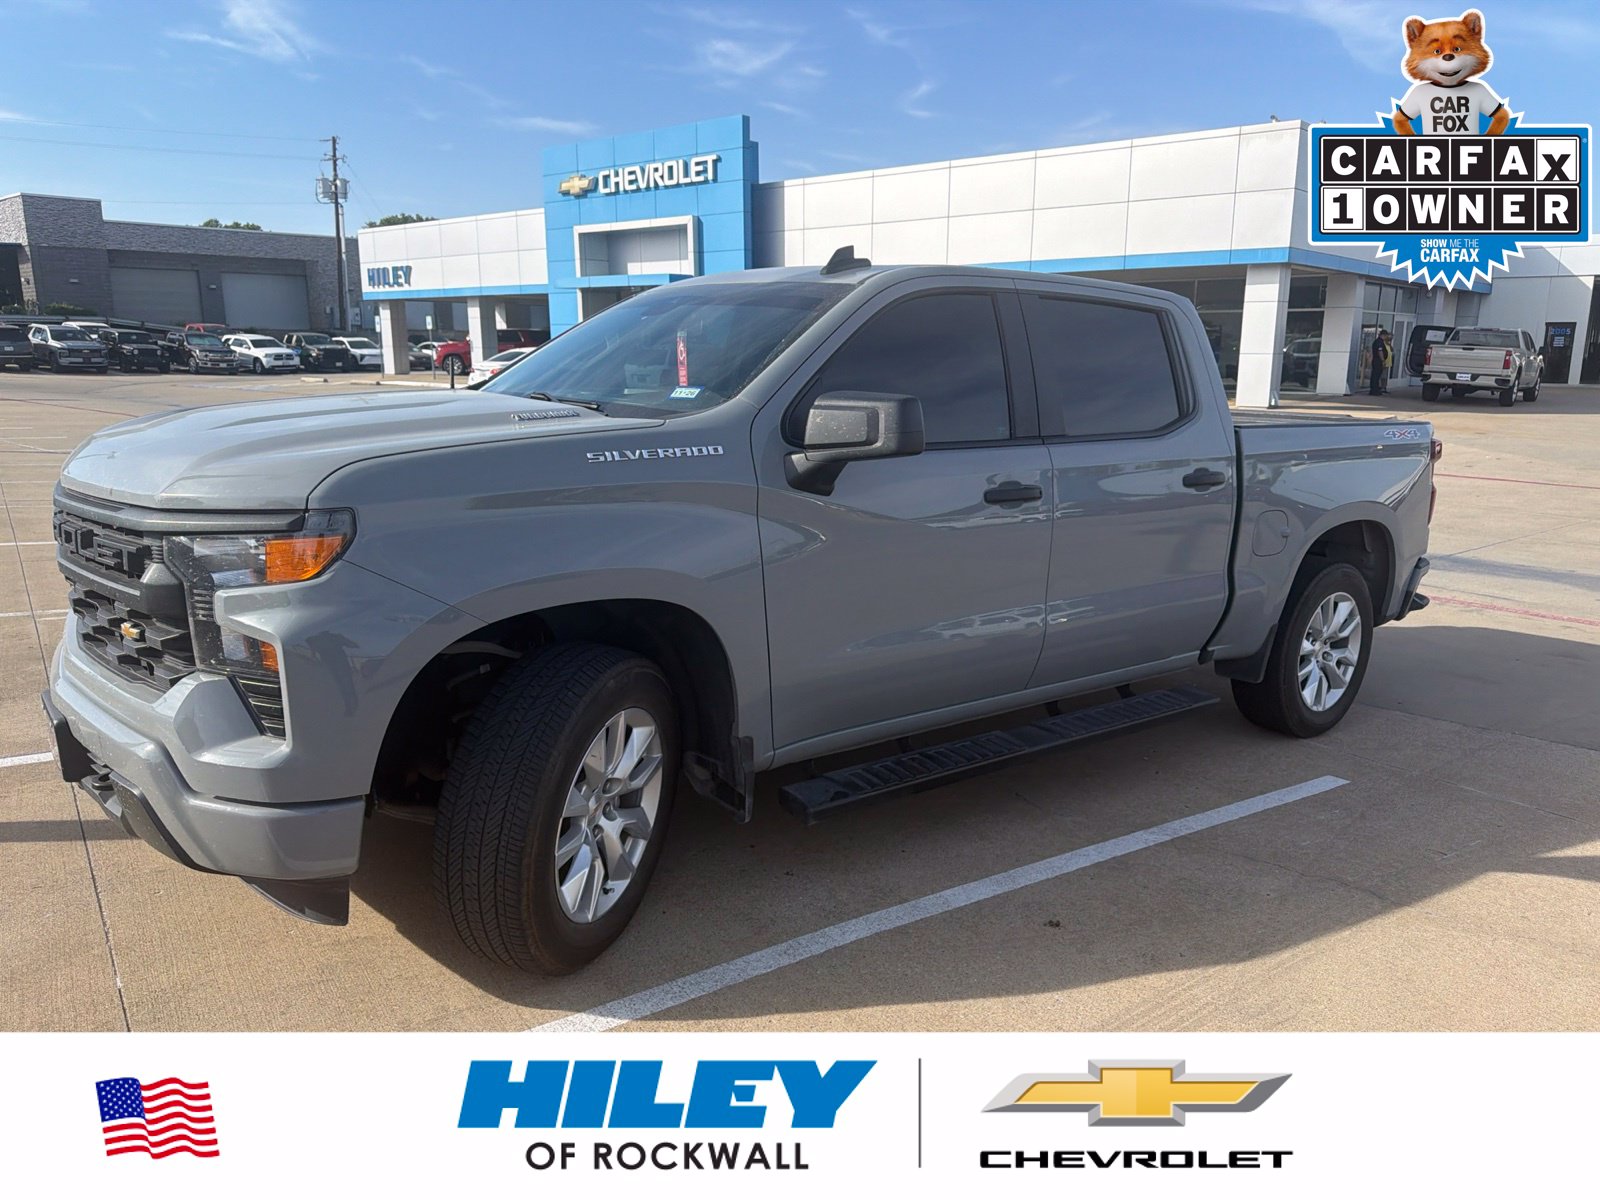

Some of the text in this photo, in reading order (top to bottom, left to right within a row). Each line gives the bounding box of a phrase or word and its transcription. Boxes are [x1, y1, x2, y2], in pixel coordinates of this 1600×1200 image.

[598, 153, 721, 195] CHEVROLET
[367, 264, 412, 288] HILEY
[586, 445, 724, 463] SILVERADO
